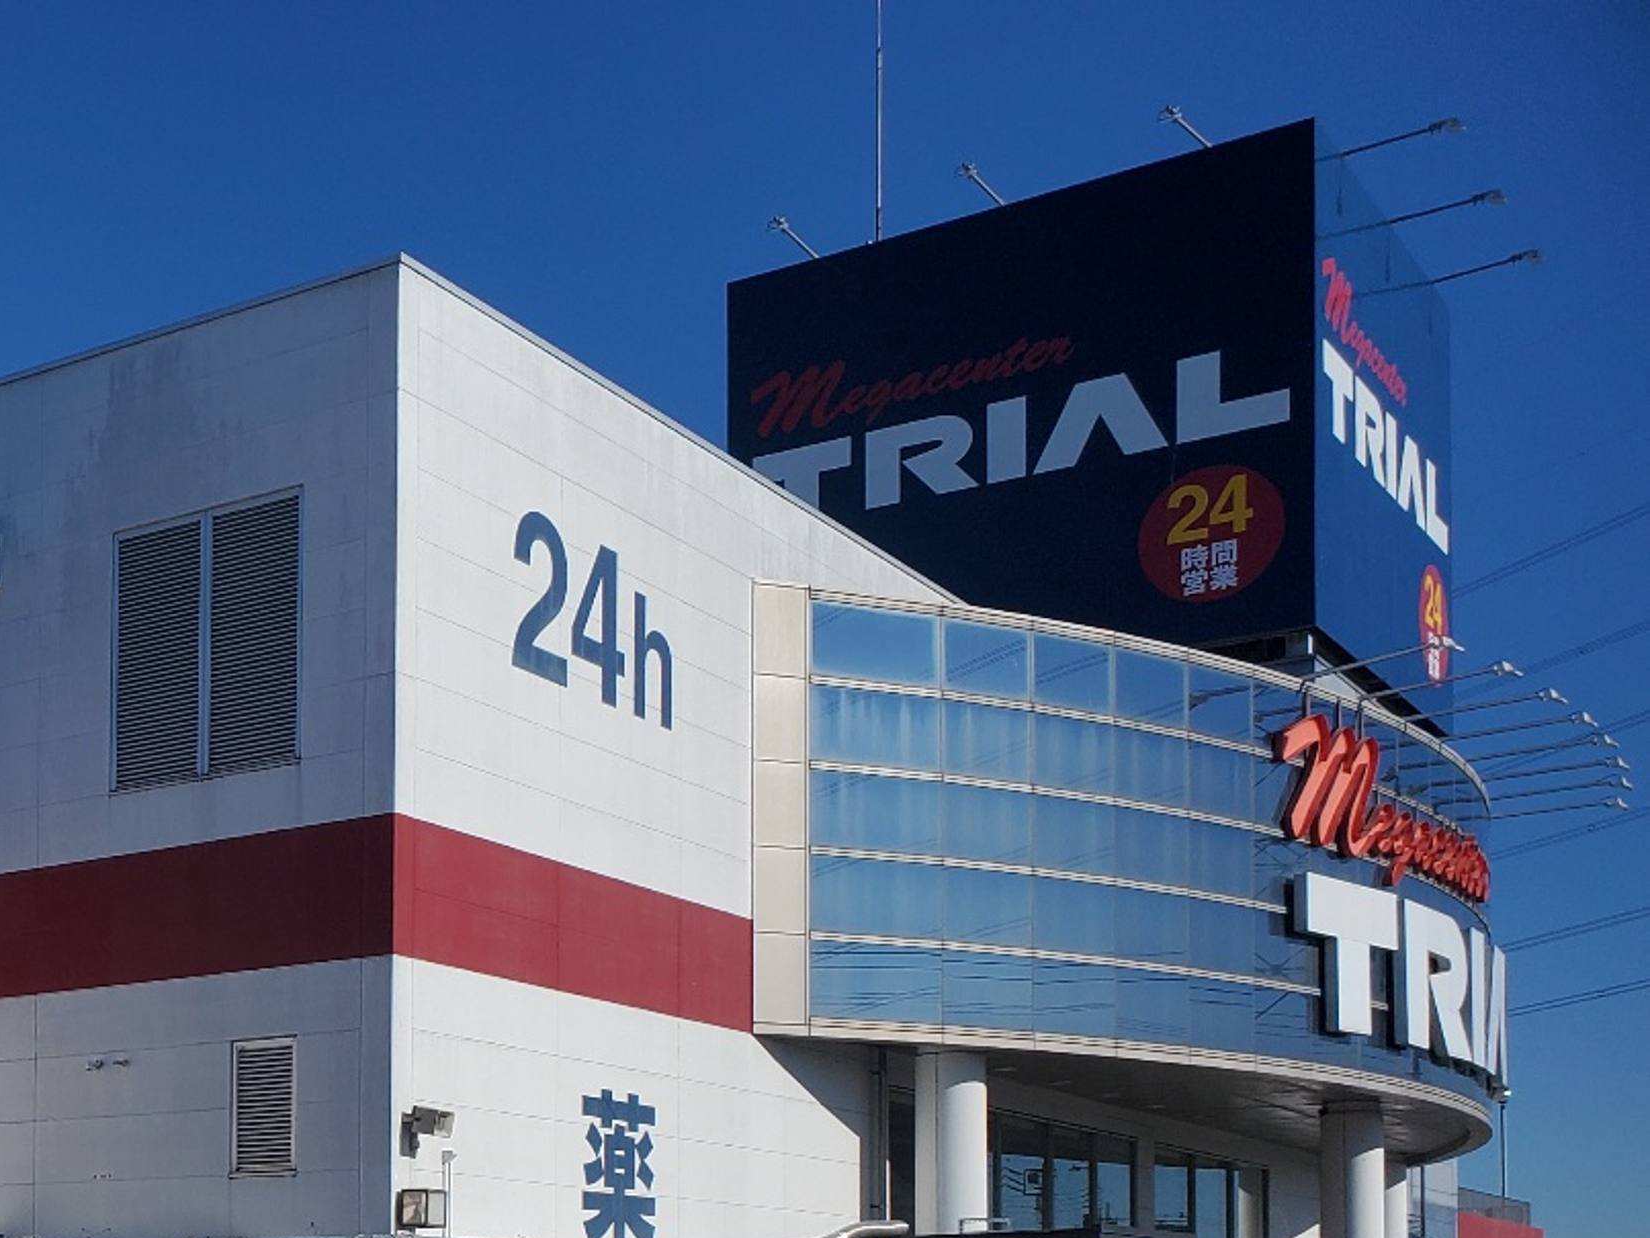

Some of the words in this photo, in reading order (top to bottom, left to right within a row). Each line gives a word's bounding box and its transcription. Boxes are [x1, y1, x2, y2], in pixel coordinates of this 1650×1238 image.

[750, 337, 1073, 438] Megacenter
[752, 349, 1291, 510] TRIAL
[1322, 338, 1449, 556] TRIAL
[1166, 474, 1254, 545] 24
[1180, 538, 1238, 571] 時間
[511, 510, 673, 731] 24h
[1180, 564, 1238, 597] 営業
